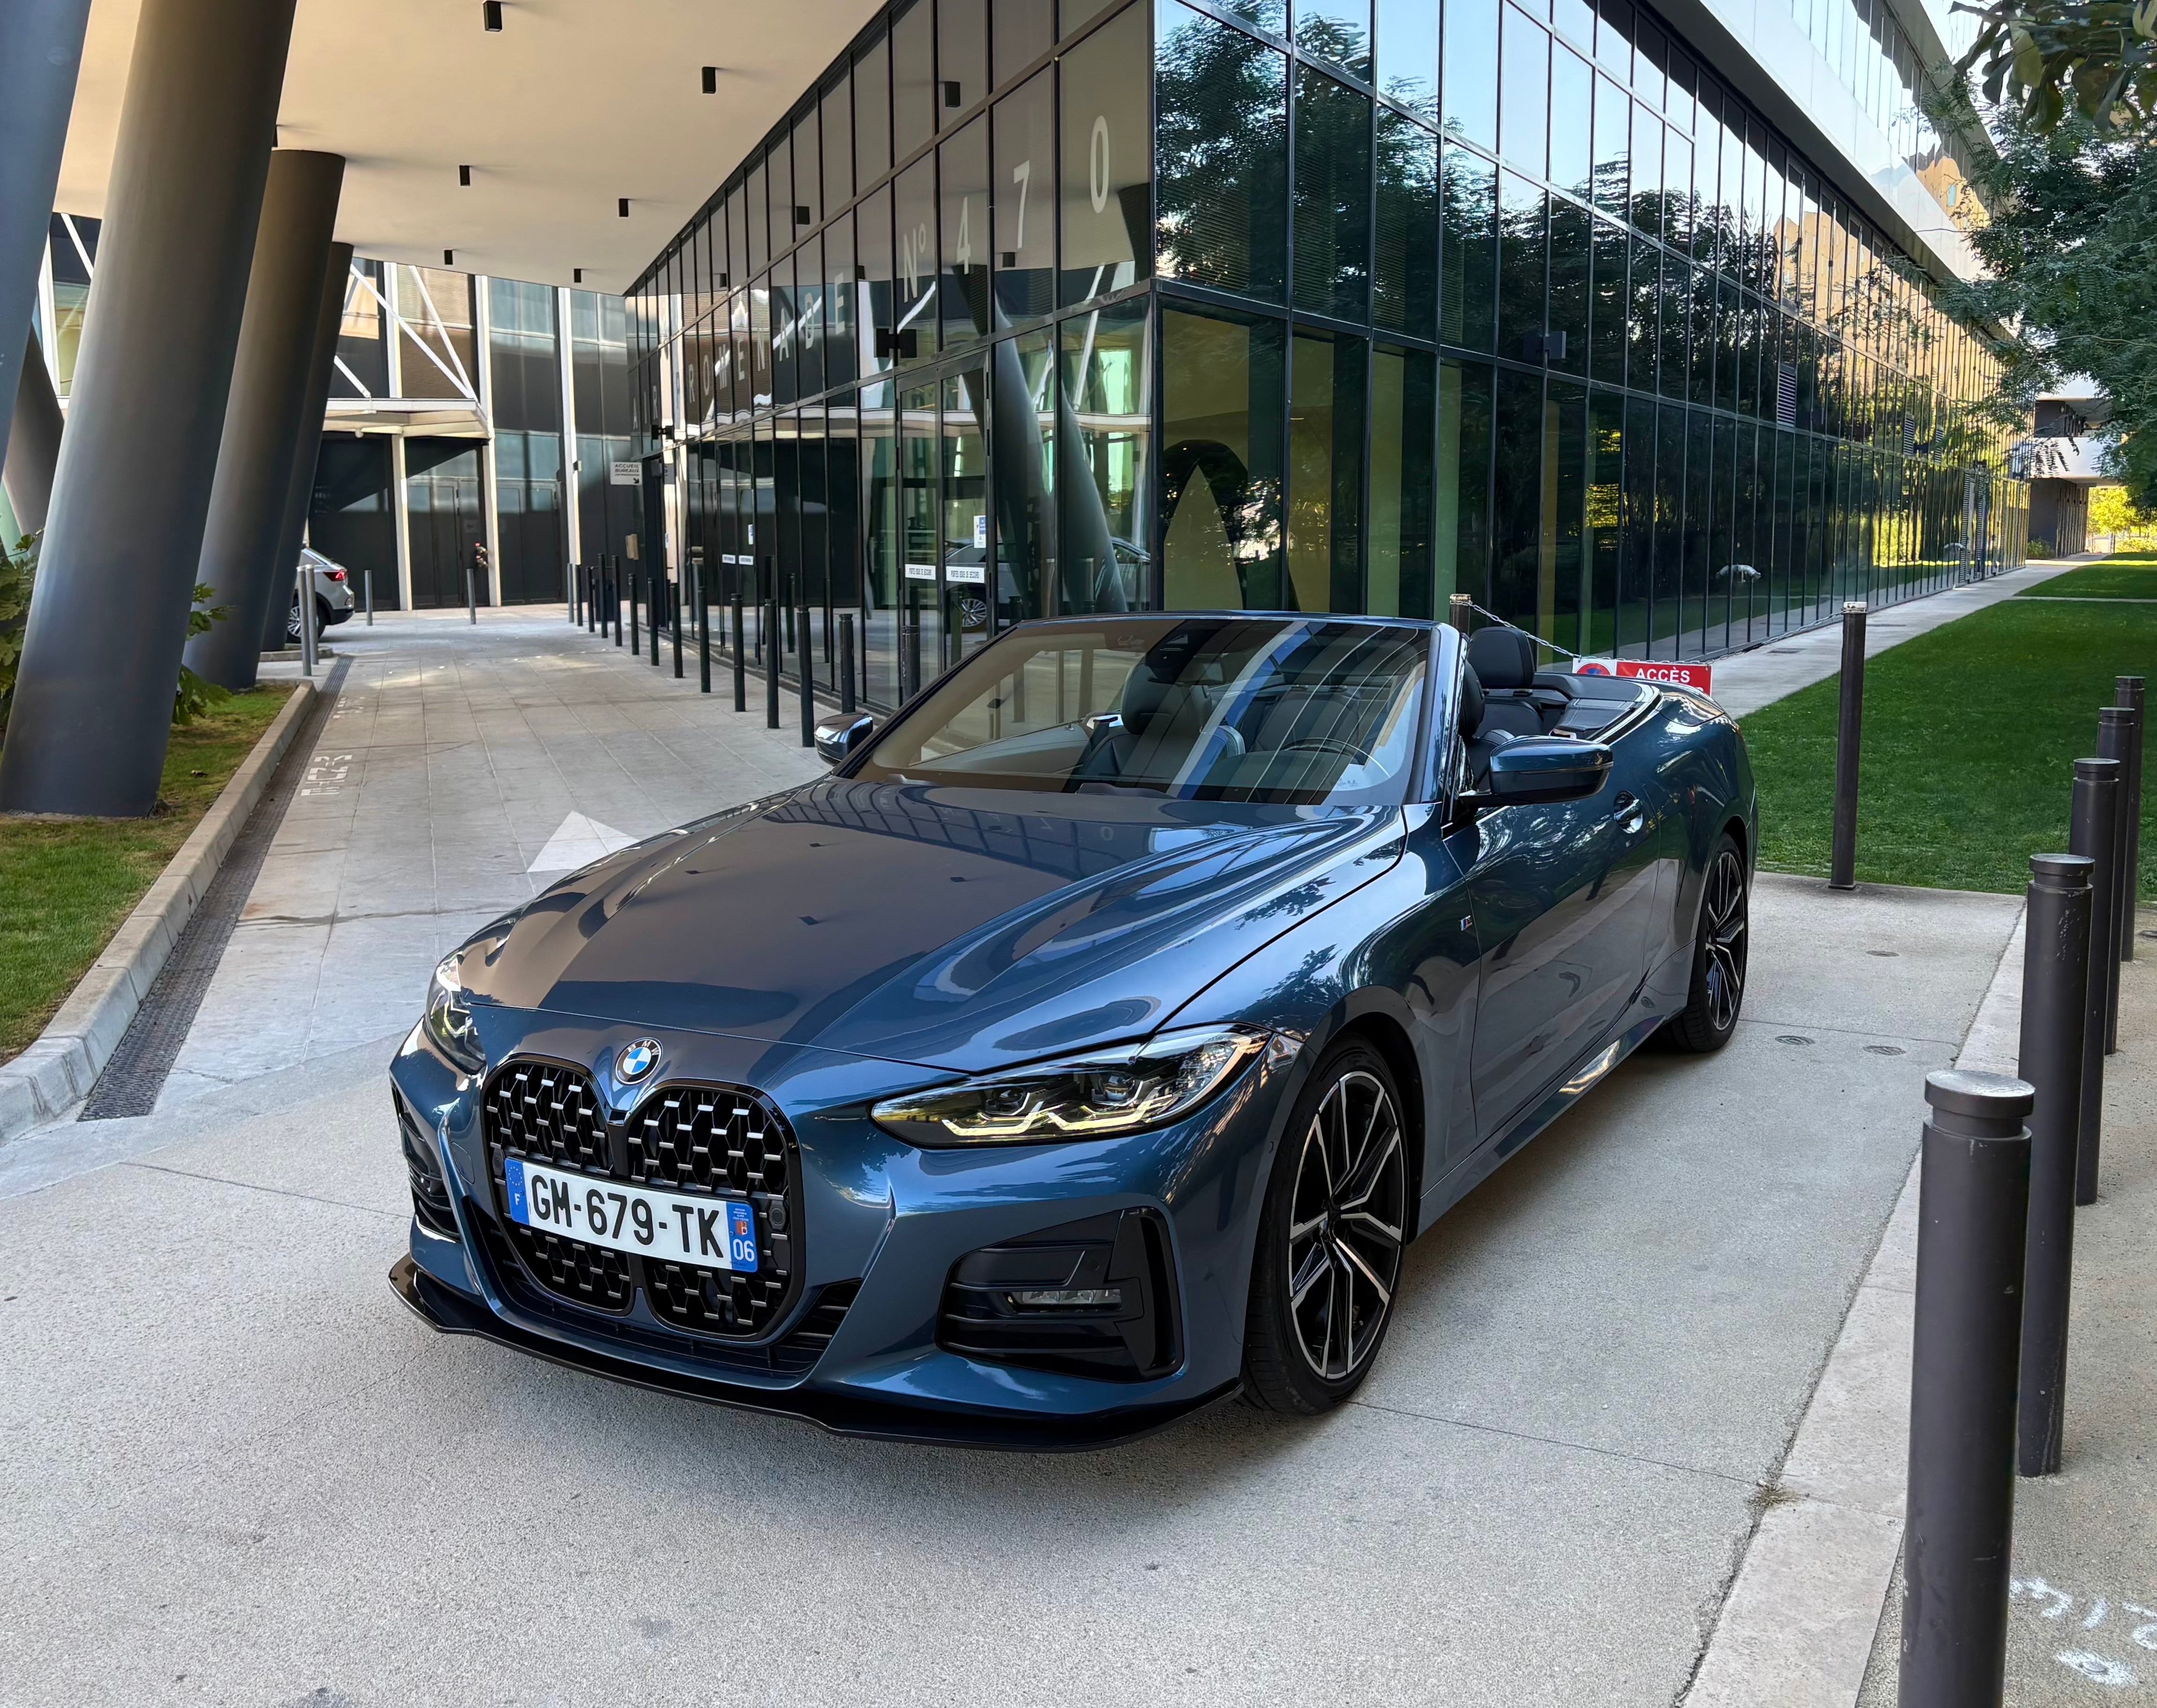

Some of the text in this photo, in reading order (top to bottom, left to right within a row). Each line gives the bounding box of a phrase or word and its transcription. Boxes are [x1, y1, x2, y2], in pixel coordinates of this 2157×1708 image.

[633, 385, 658, 430] AIR
[676, 271, 846, 409] PROMENADE
[1635, 666, 1690, 683] ACCÈS
[627, 1040, 660, 1056] BMW
[514, 1193, 520, 1205] F
[531, 1174, 724, 1258] GM-679-TK
[732, 1238, 755, 1262] 06
